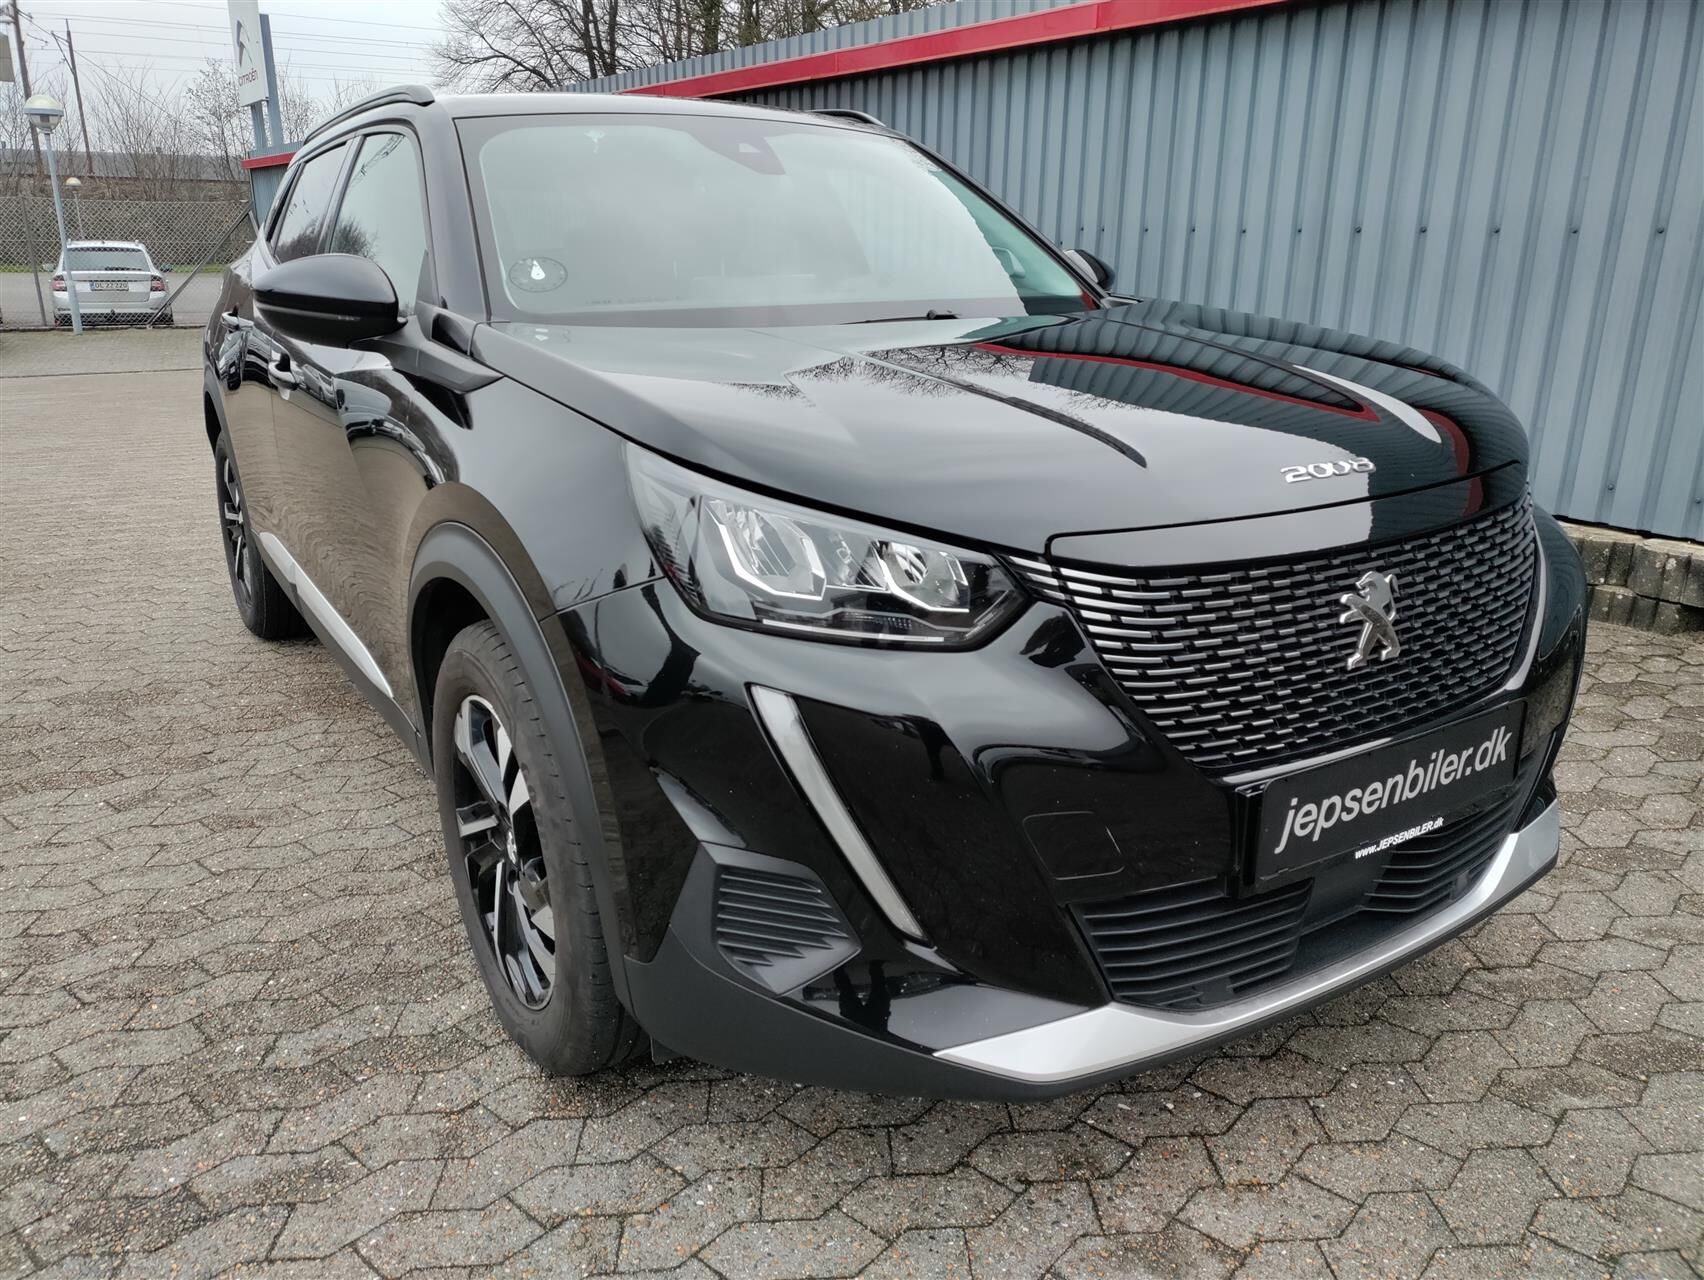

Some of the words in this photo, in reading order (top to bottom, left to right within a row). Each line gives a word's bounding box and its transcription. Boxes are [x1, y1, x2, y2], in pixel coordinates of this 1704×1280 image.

[1282, 457, 1376, 483] 2008
[1274, 726, 1512, 854] jepsenbiler.dk
[1355, 816, 1444, 859] www.JEPSENBILER.dk
